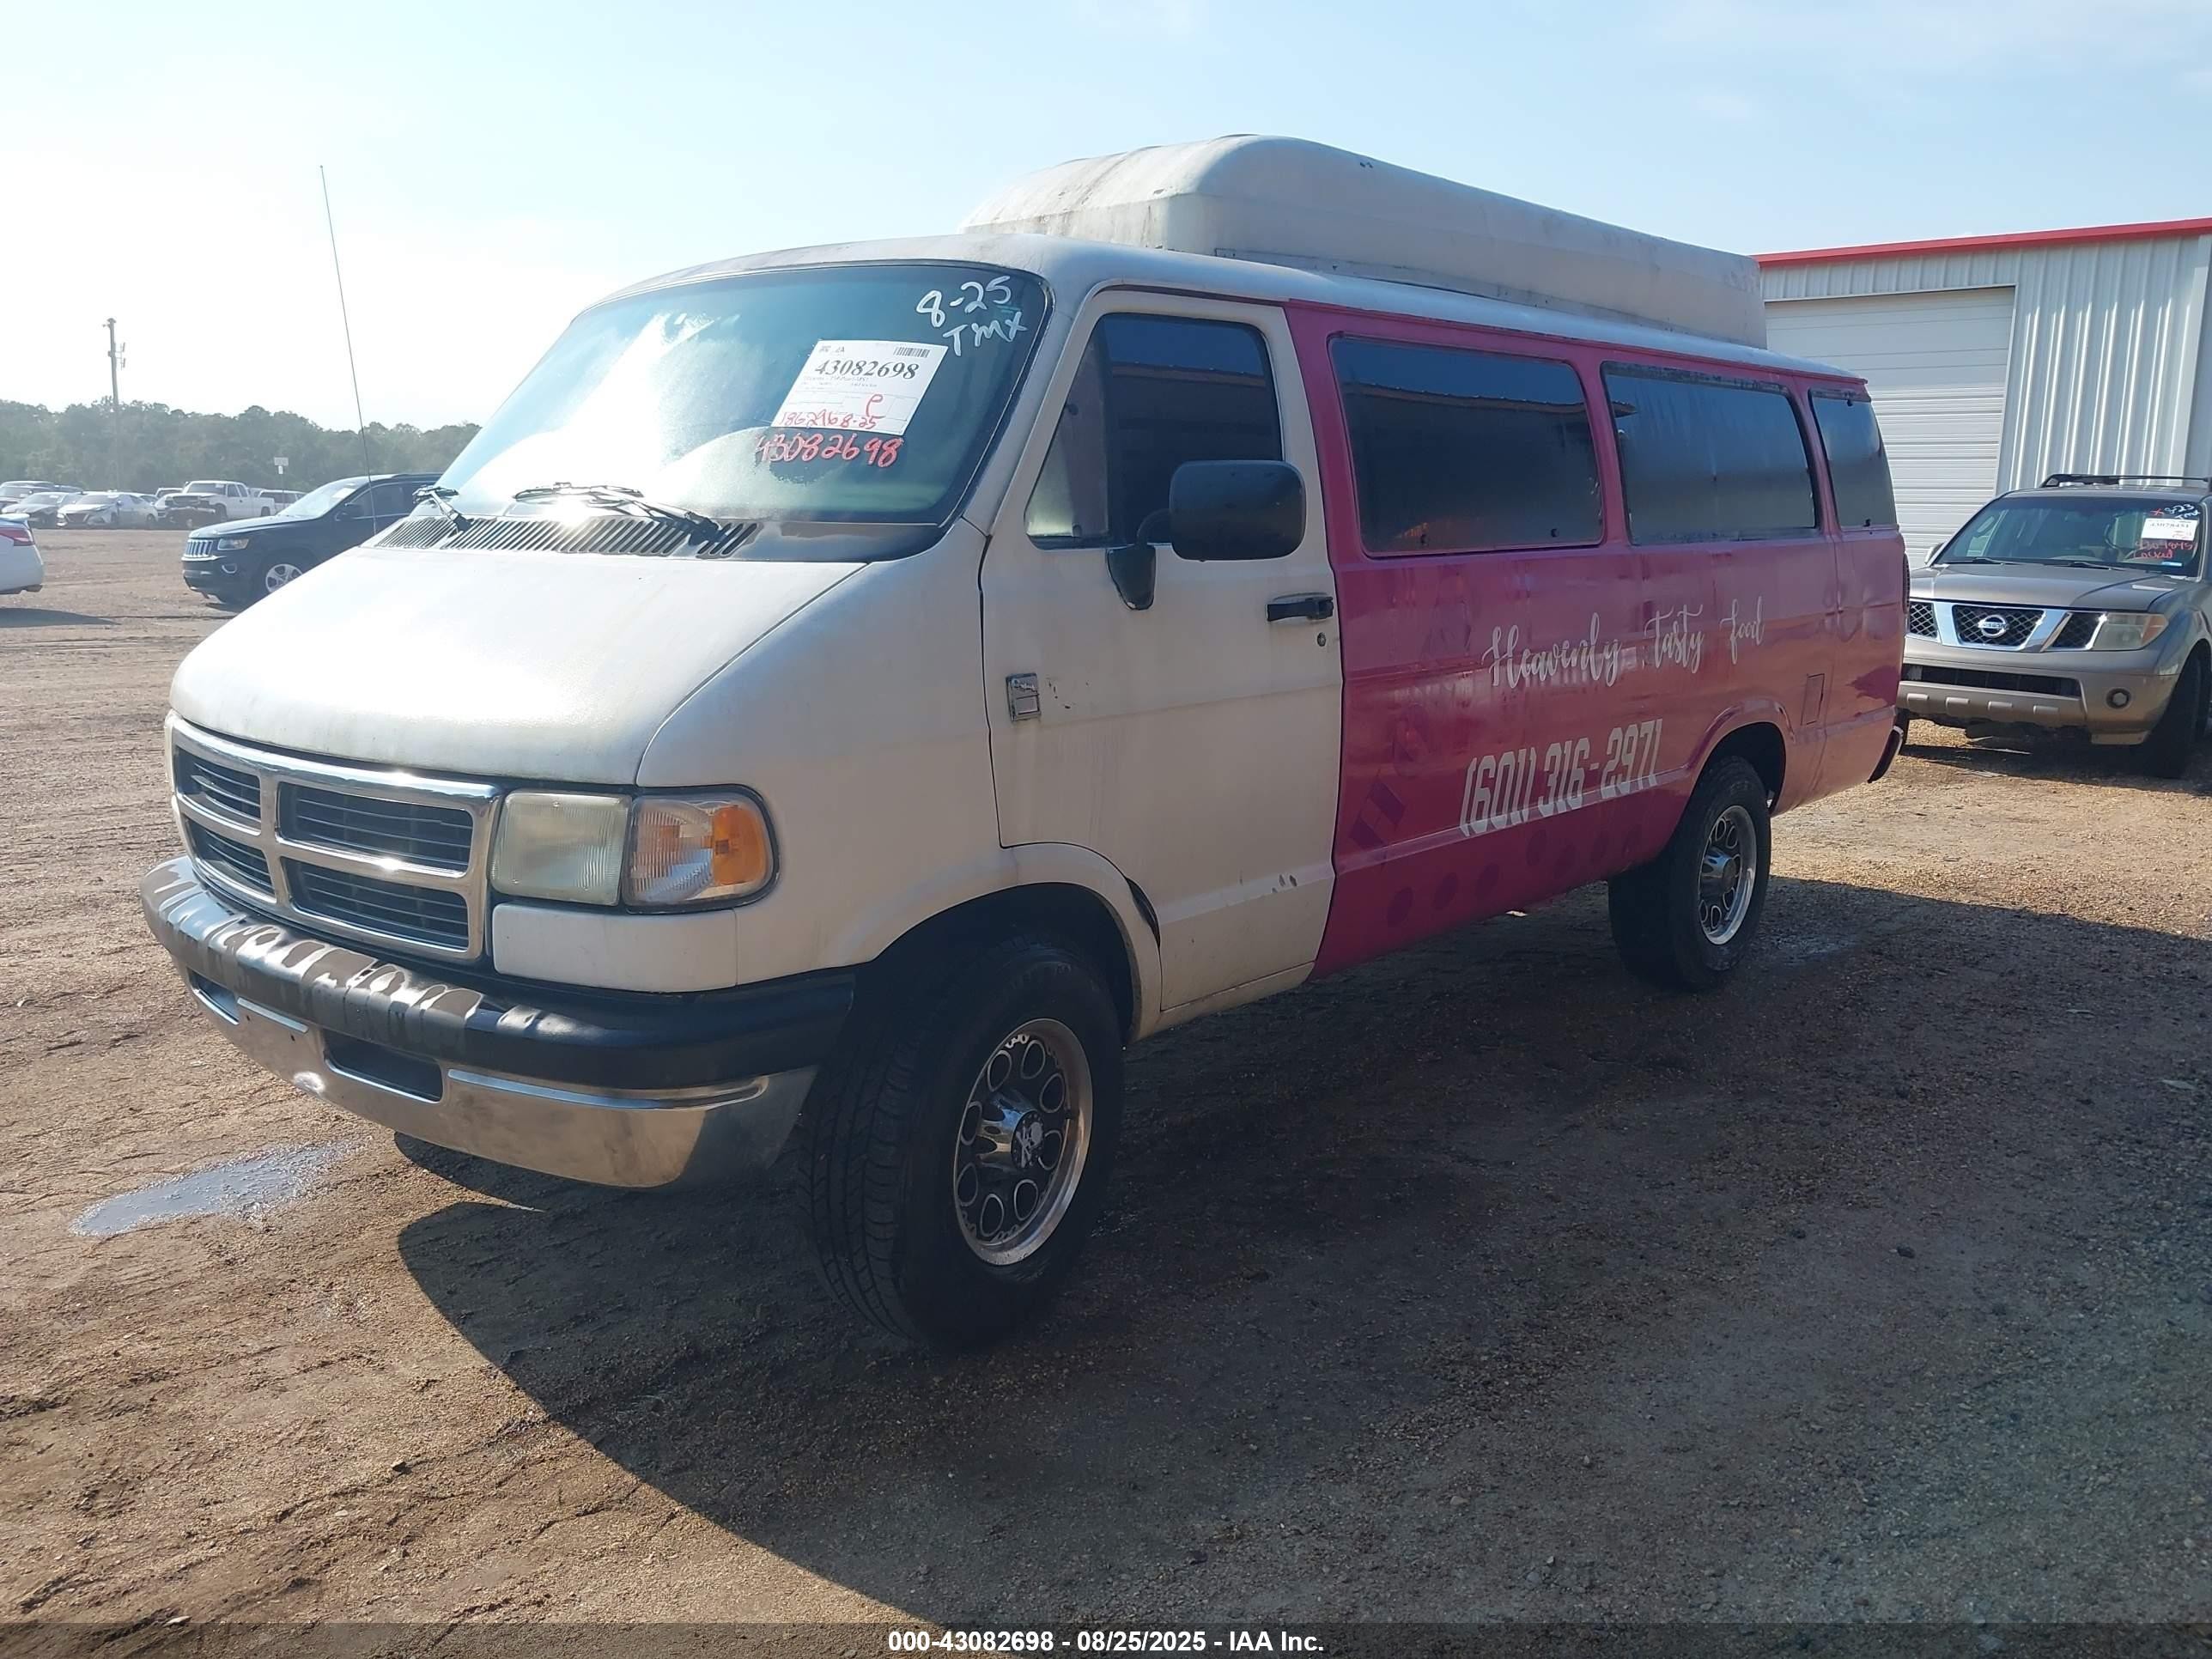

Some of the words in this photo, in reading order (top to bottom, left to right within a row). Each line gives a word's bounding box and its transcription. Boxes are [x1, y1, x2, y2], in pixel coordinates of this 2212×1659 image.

[915, 275, 1012, 328] 8-25
[814, 359, 920, 380] 43082698
[756, 432, 904, 468] 43082698
[1481, 611, 1621, 689] Heavenly
[1719, 596, 1765, 665] food
[1459, 746, 1537, 837] (601)
[1538, 718, 1663, 817] 316-2971
